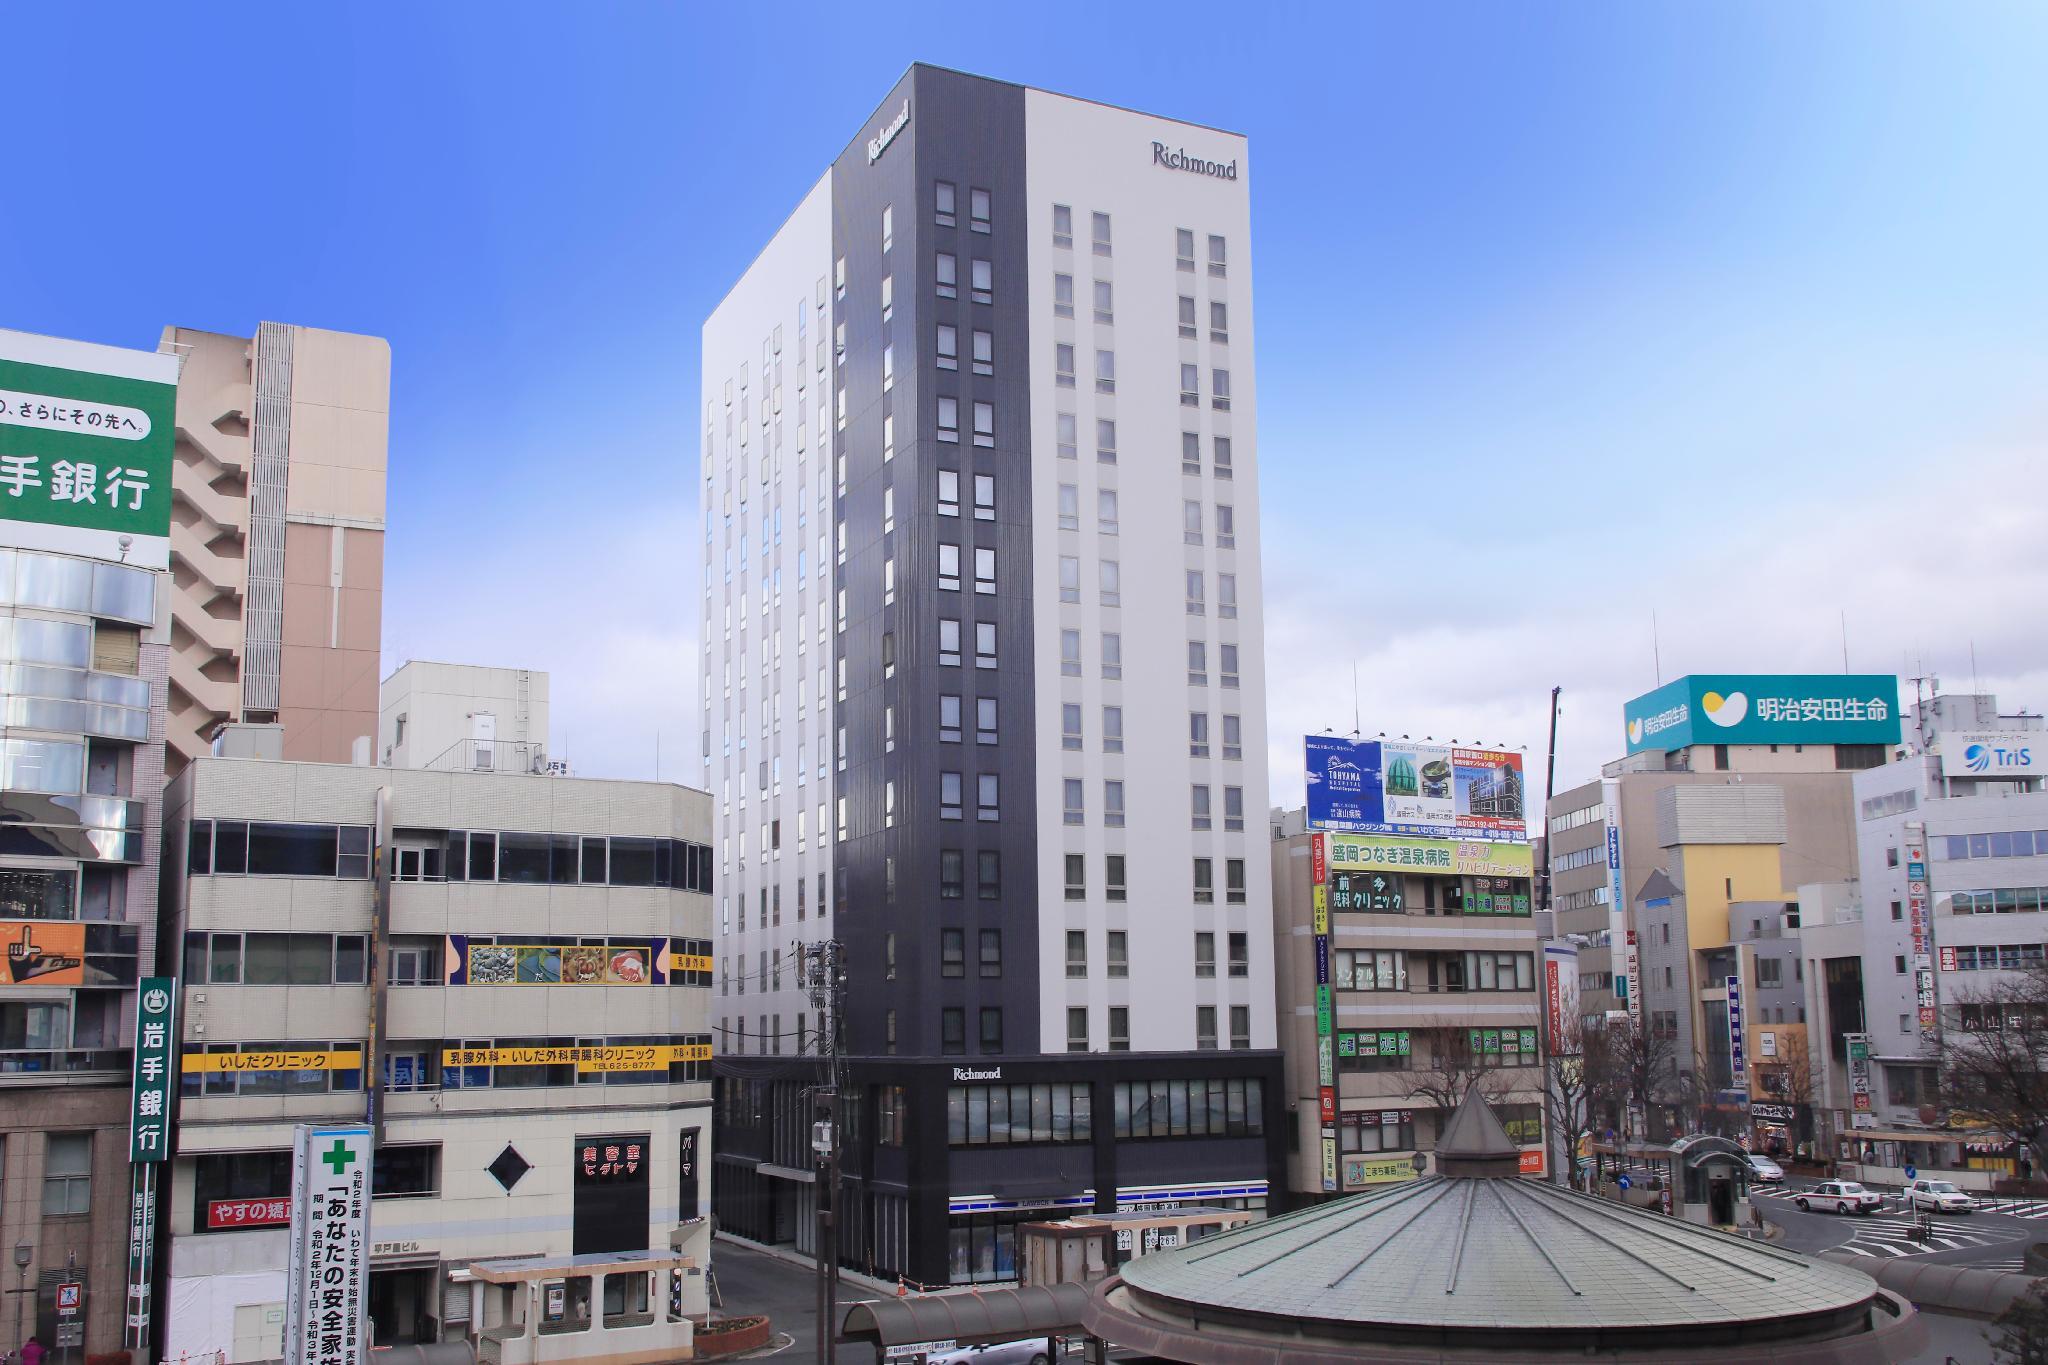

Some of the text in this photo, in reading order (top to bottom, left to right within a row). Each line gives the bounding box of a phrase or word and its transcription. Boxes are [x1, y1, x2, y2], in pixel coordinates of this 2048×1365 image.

[868, 100, 910, 166] Richmond
[1151, 141, 1238, 181] Richmond
[0, 455, 150, 511] 手銀行
[1644, 703, 1688, 735] 明治安田生命
[1757, 698, 1888, 722] 明治安田生命
[1994, 748, 2031, 766] TriS
[1329, 770, 1361, 781] TOHYAMA
[1332, 844, 1450, 867] 盛岡つなぎ温泉病院
[1457, 861, 1531, 876] リハビリテーション
[220, 1054, 326, 1069] いしだクリニック
[953, 1066, 1001, 1081] Richmond
[138, 1022, 165, 1151] 岩手銀行
[583, 1145, 641, 1162] 美容室
[351, 1170, 363, 1219] 令和2年度
[133, 1192, 144, 1257] 岩手銀行
